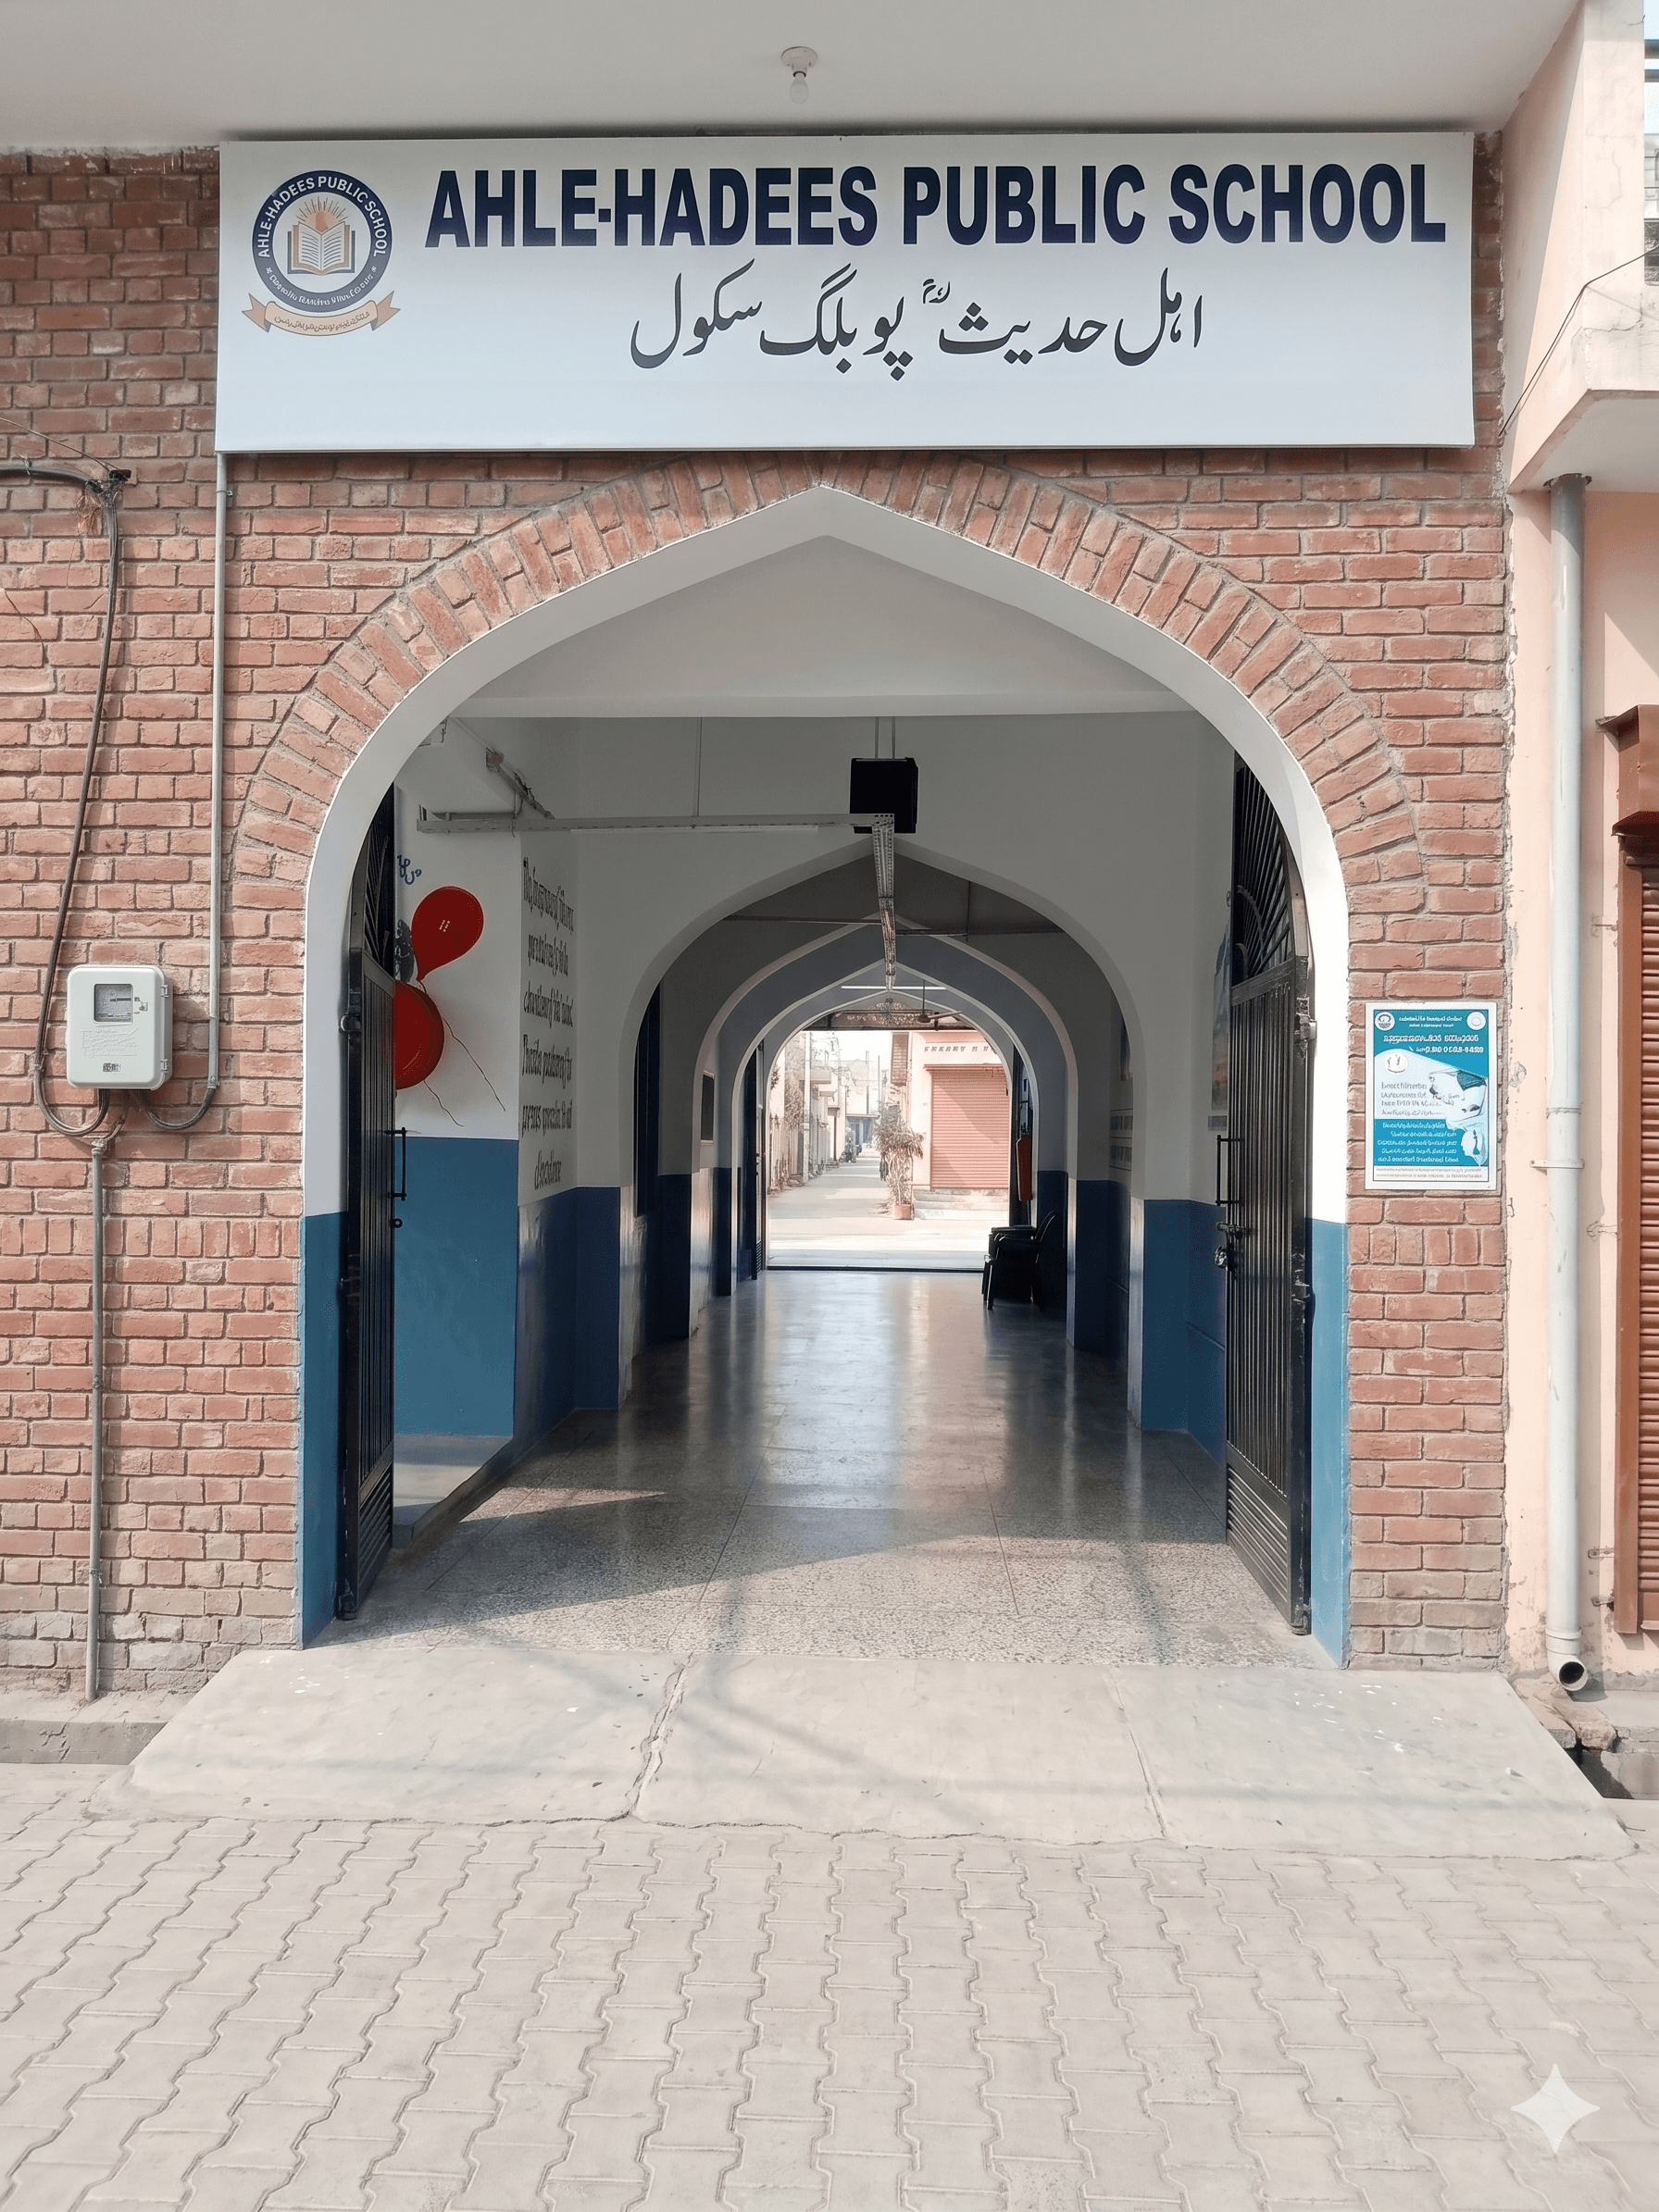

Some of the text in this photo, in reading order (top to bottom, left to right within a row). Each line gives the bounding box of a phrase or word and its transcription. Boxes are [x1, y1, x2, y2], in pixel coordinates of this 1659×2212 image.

[318, 176, 369, 204] PUBLIC
[364, 200, 388, 257] SCHOOL
[424, 163, 1446, 248] AHLE-HADEES PUBLIC SCHOOL
[630, 258, 763, 368] سکول
[939, 301, 1108, 365] حدیث
